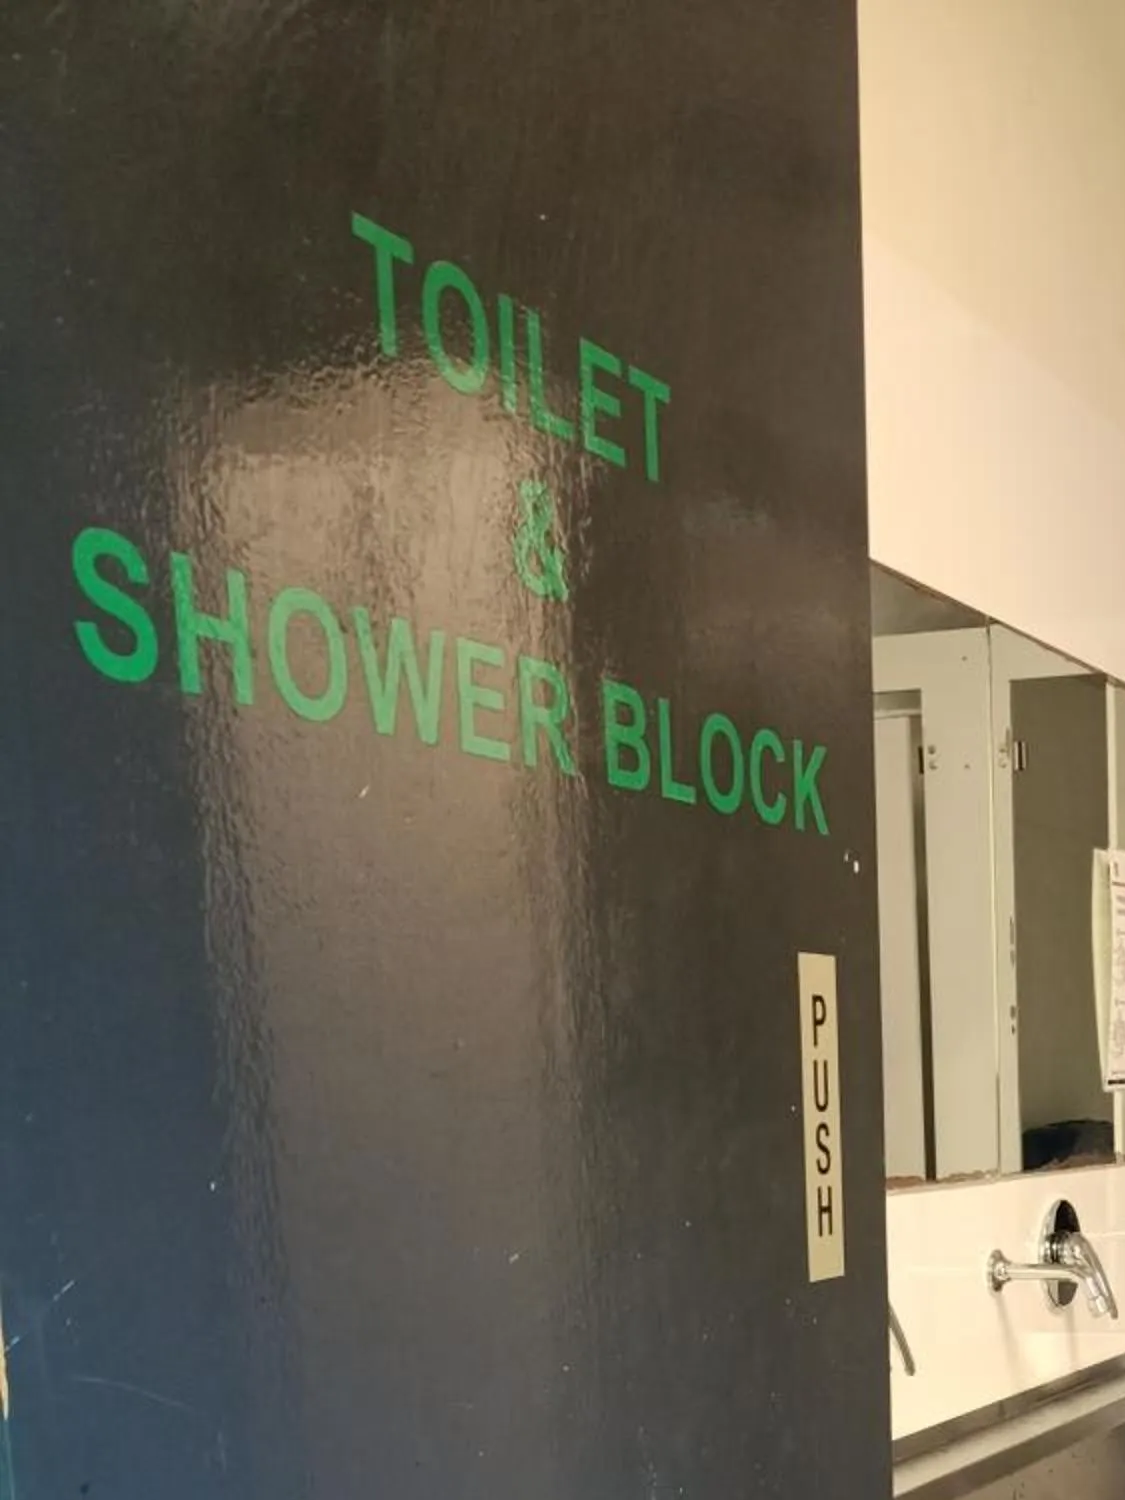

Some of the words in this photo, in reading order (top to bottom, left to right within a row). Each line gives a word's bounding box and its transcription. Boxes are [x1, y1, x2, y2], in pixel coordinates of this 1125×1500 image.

[352, 211, 670, 481] TOILET
[514, 481, 568, 600] &
[72, 527, 575, 776] SHOWER
[602, 679, 829, 835] BLOCK
[811, 994, 833, 1237] PUSH
